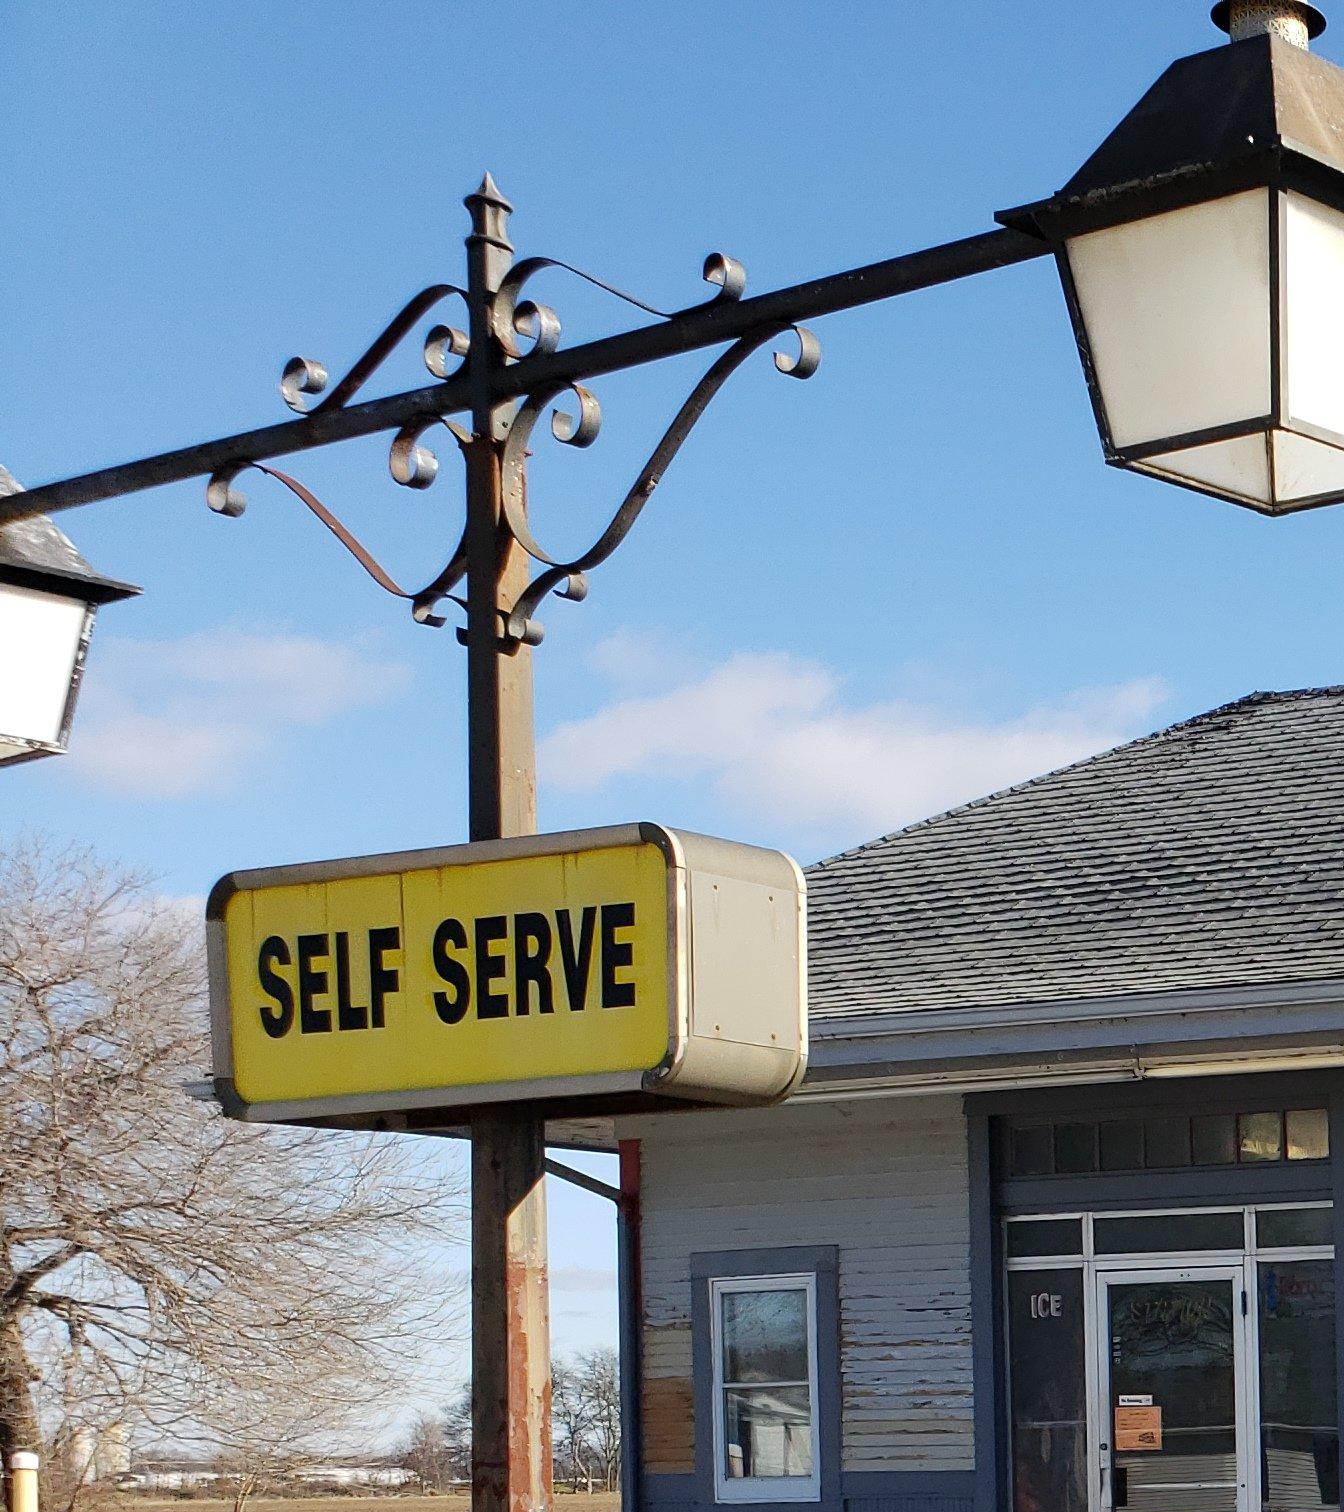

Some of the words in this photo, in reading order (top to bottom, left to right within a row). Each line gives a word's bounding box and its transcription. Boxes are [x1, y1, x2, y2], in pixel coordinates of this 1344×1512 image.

[258, 926, 400, 1039] SELF
[432, 903, 636, 1025] SERVE
[1030, 1292, 1062, 1318] ICE
